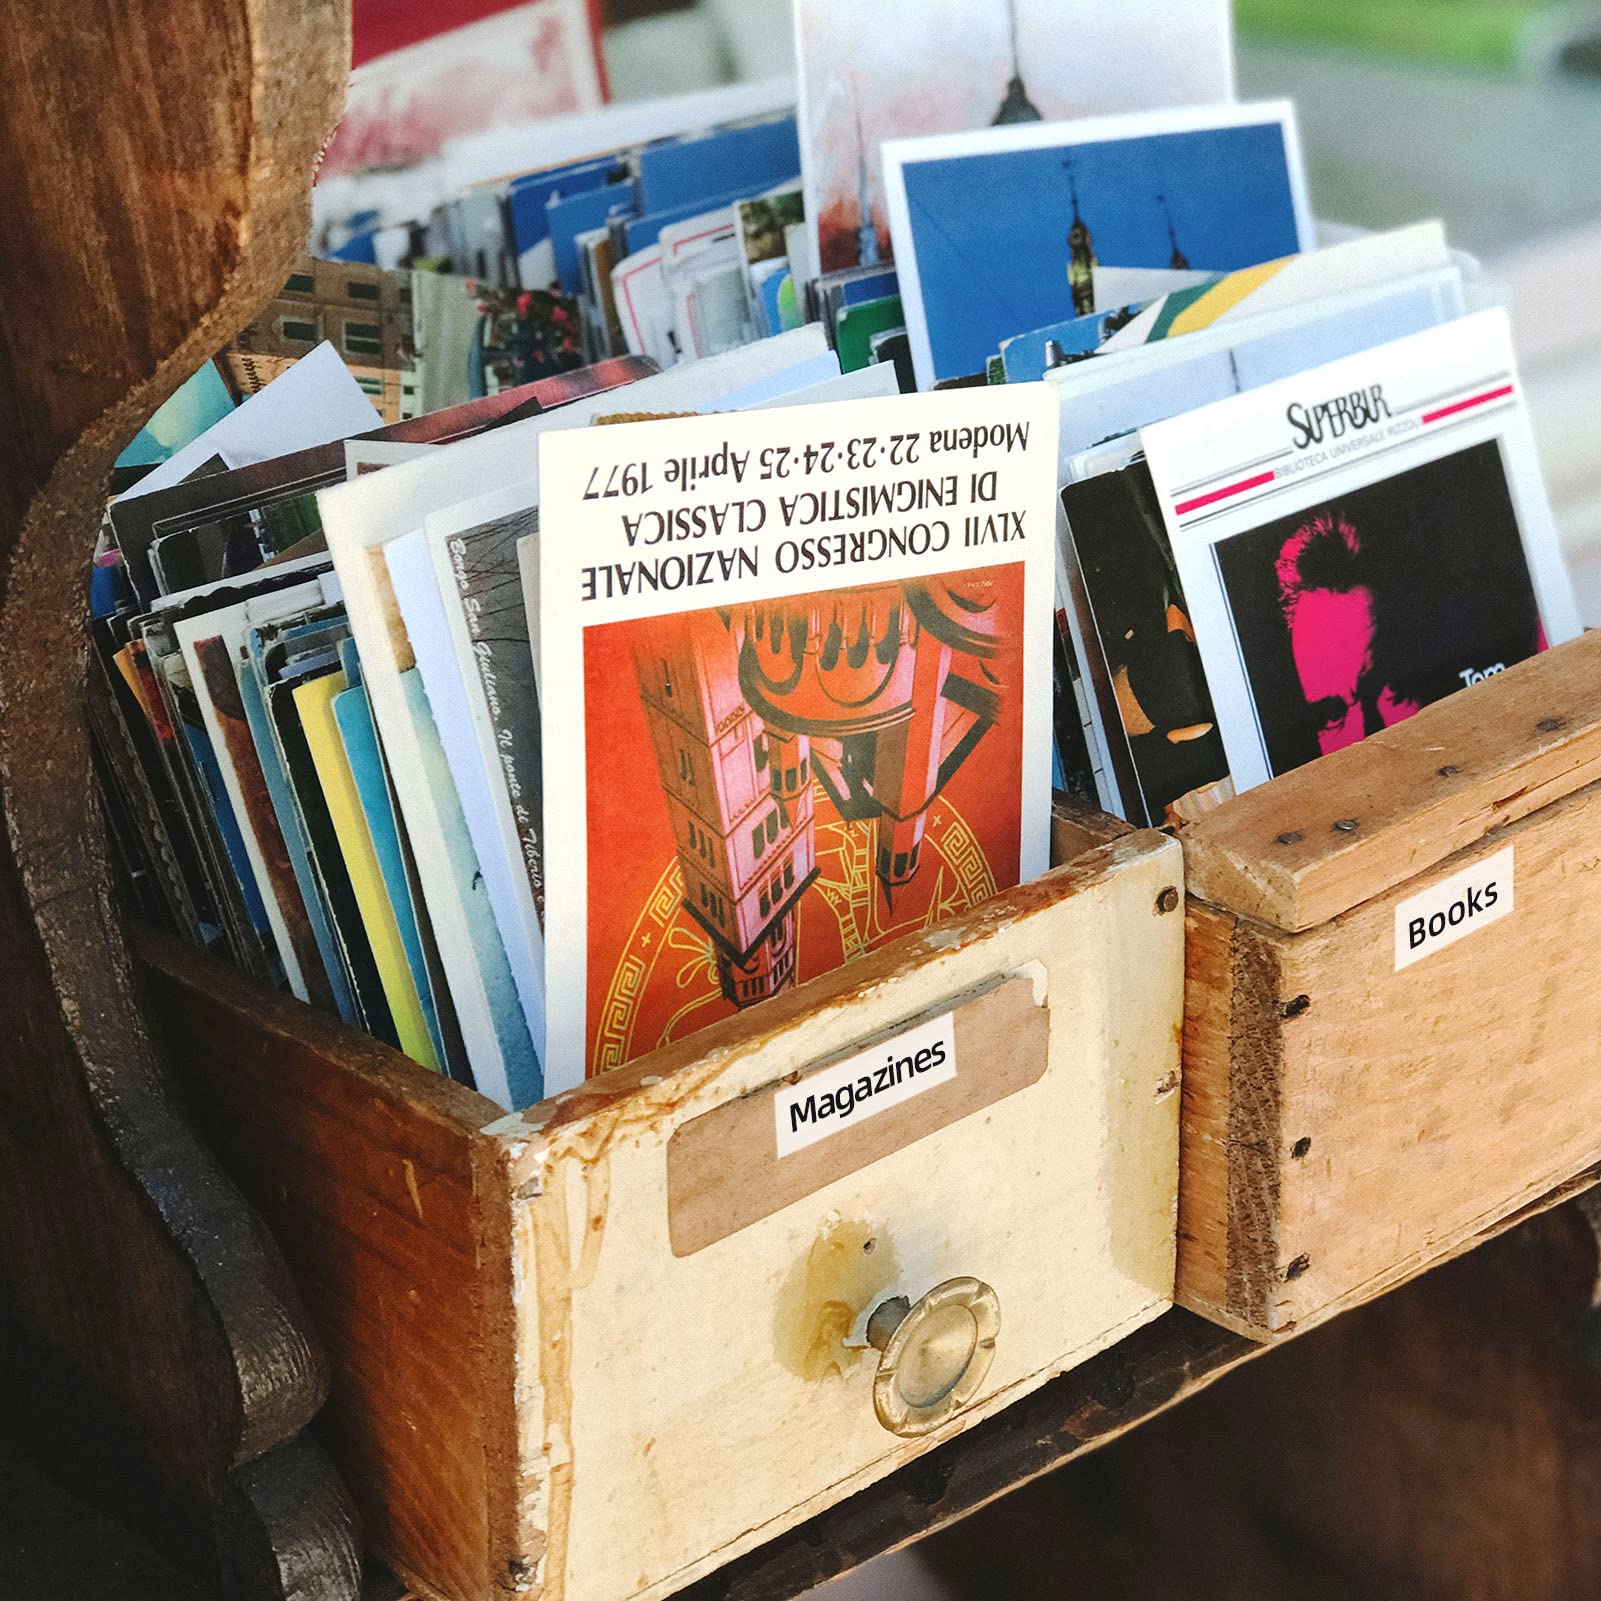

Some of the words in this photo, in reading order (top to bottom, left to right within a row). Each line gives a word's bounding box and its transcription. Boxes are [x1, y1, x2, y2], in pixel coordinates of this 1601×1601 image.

[929, 421, 1030, 459] Modena
[1274, 451, 1329, 478] BIBLIOTECA
[1329, 430, 1385, 458] UNIVERSALE
[582, 462, 654, 501] 1977
[664, 441, 750, 492] Aprile
[970, 471, 998, 504] DI
[621, 499, 768, 547] CLASSICA
[779, 475, 959, 527] ENIGMISTICA
[775, 520, 951, 574] CONGRESSO
[964, 510, 1027, 547] XLVII
[450, 538, 470, 591] Borgo
[581, 545, 759, 601] NAZIONALE
[463, 597, 482, 638] San
[500, 754, 522, 799] ponte
[516, 804, 529, 824] di
[522, 828, 543, 889] Tiberio
[1408, 881, 1498, 950] Books
[789, 1040, 946, 1133] Magazines
